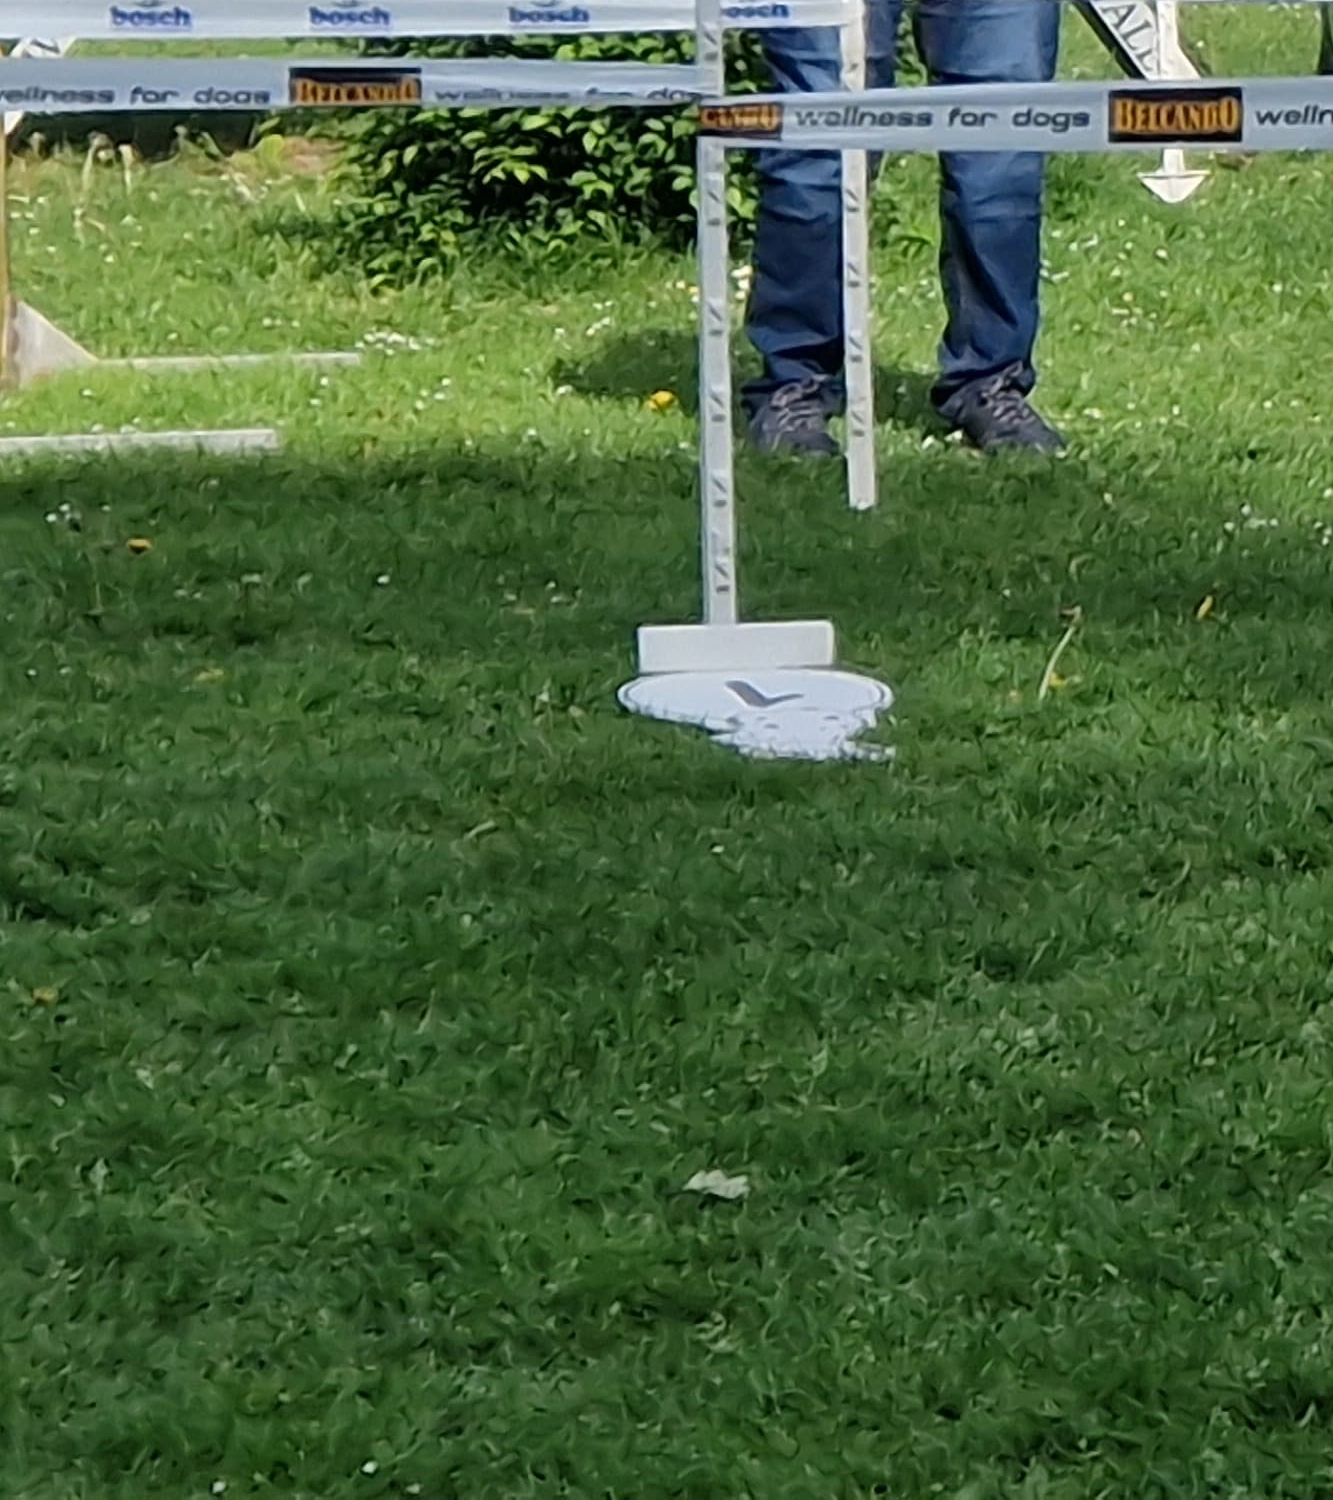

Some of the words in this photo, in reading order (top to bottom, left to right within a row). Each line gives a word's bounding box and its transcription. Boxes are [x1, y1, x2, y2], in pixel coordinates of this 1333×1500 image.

[110, 6, 192, 26] bosch
[310, 6, 391, 26] bosch
[508, 5, 590, 24] bosch
[0, 86, 115, 104] ellness
[129, 86, 181, 105] for
[795, 106, 933, 128] wellness
[947, 107, 997, 128] for
[1012, 106, 1091, 134] dogs
[1114, 95, 1240, 135] BELCANDO
